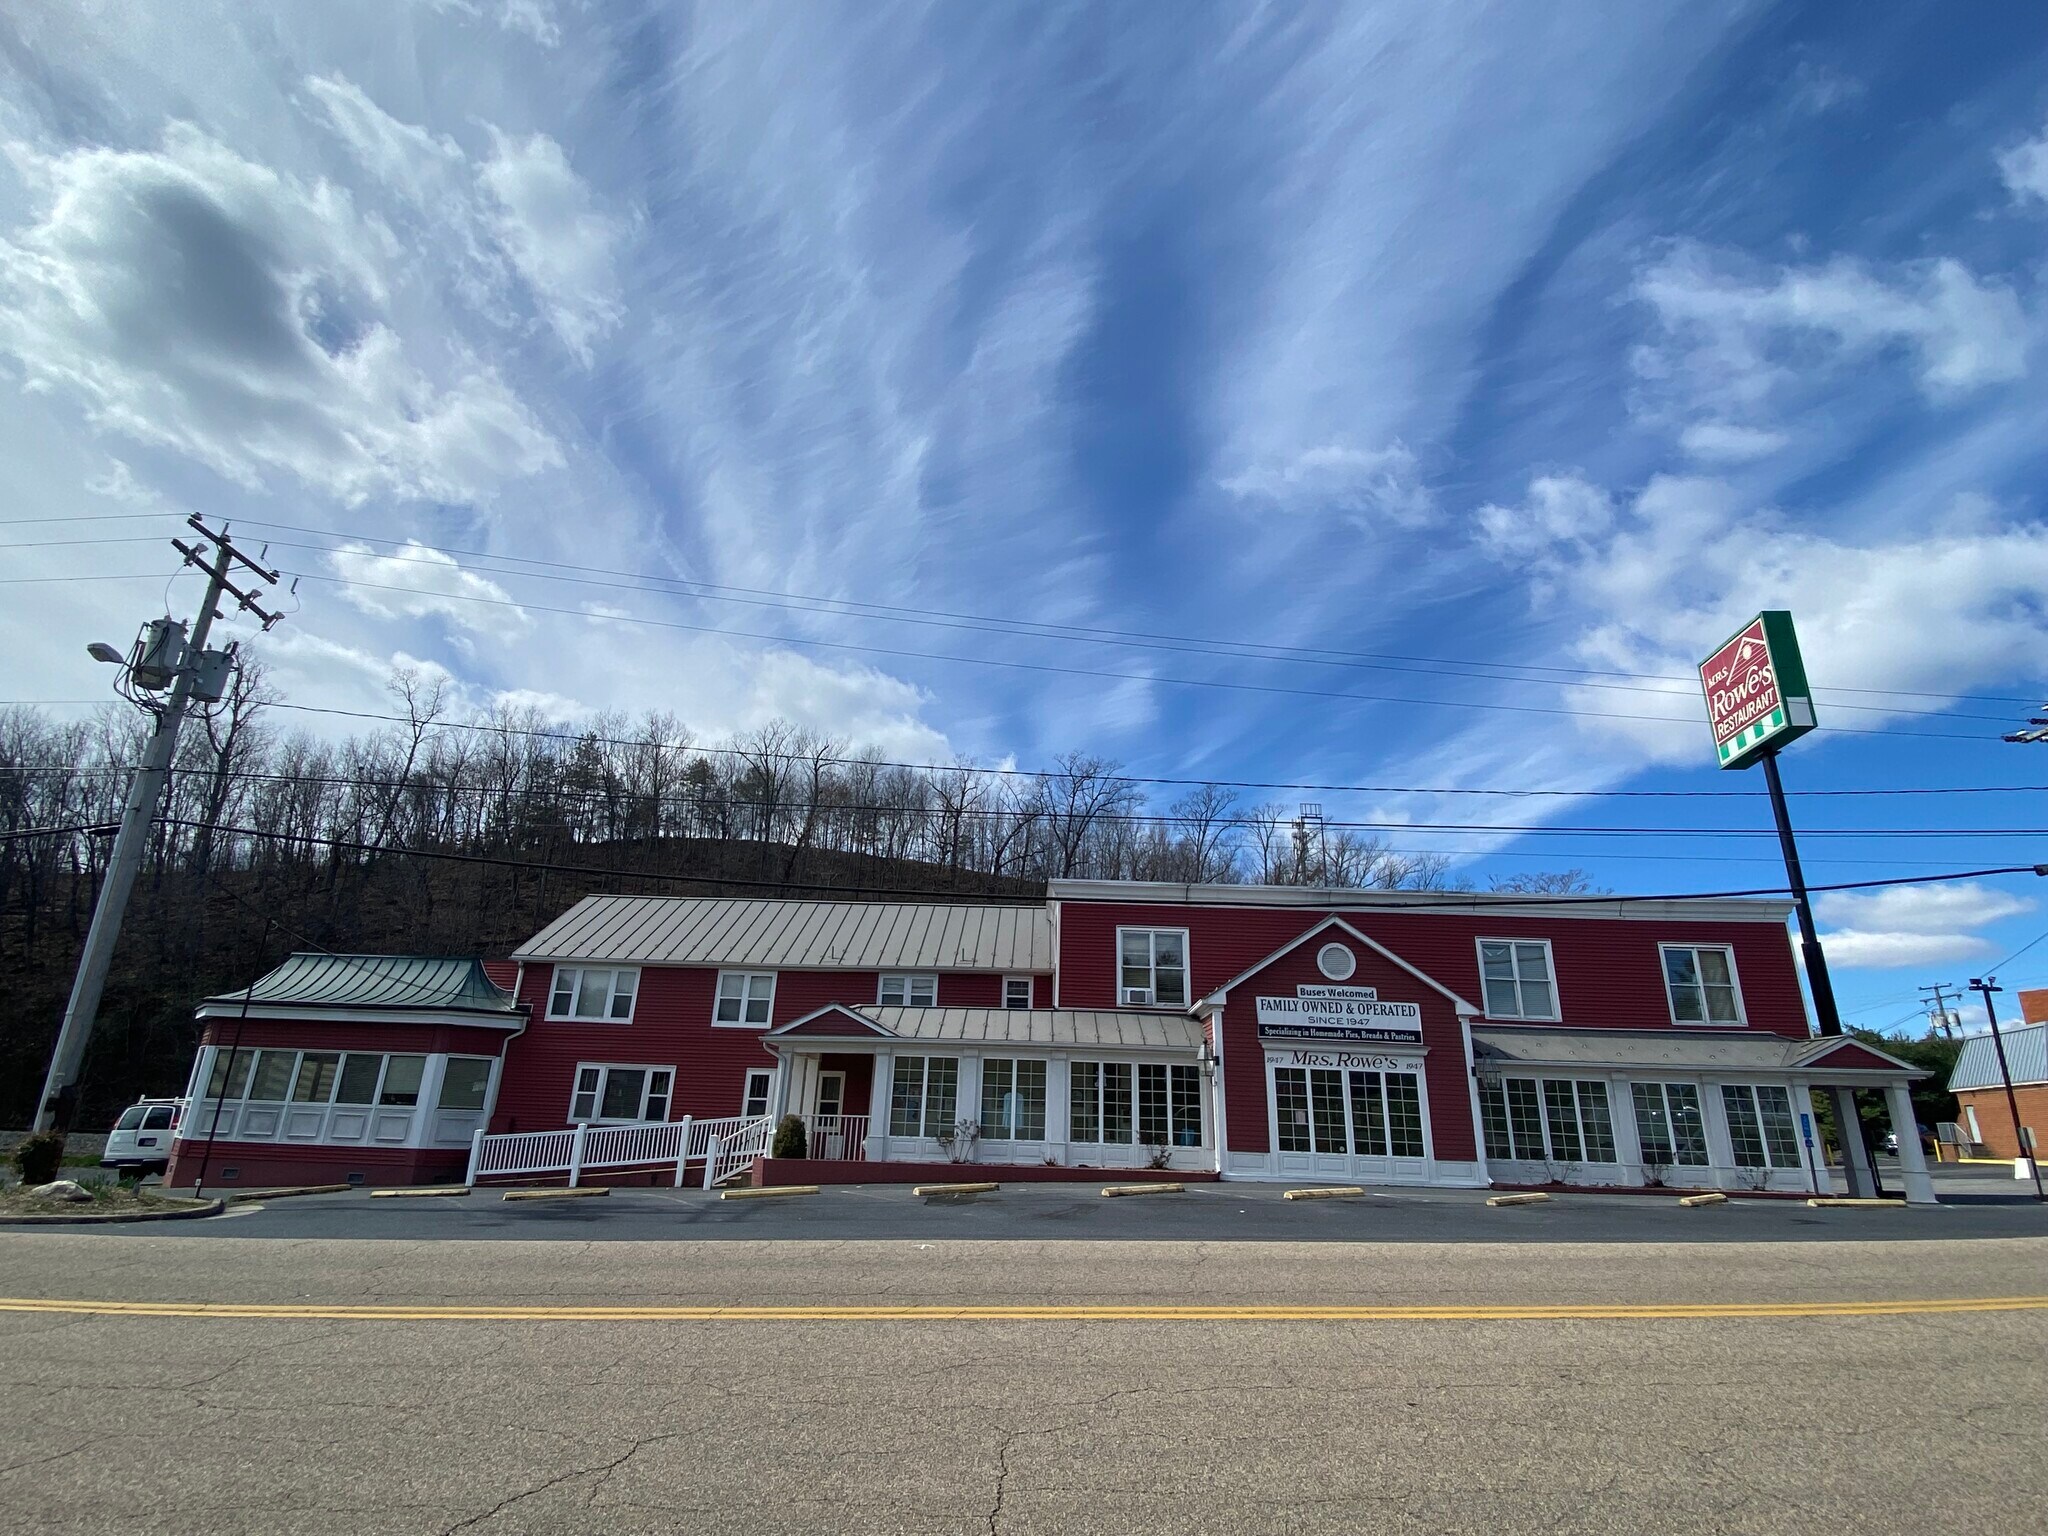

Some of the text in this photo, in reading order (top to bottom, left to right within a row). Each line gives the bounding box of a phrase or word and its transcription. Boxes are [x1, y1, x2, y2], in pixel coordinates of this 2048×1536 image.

[1708, 666, 1729, 689] MRS
[1717, 688, 1774, 738] RESTAURANT
[1300, 988, 1375, 999] Buses Welcomed
[1260, 999, 1416, 1017] FAMILY OWNED & OPERATED
[1308, 1016, 1370, 1026] SINCE 1947
[1264, 1026, 1415, 1041] Specializing in Homemade Pies, Breads & Pastries
